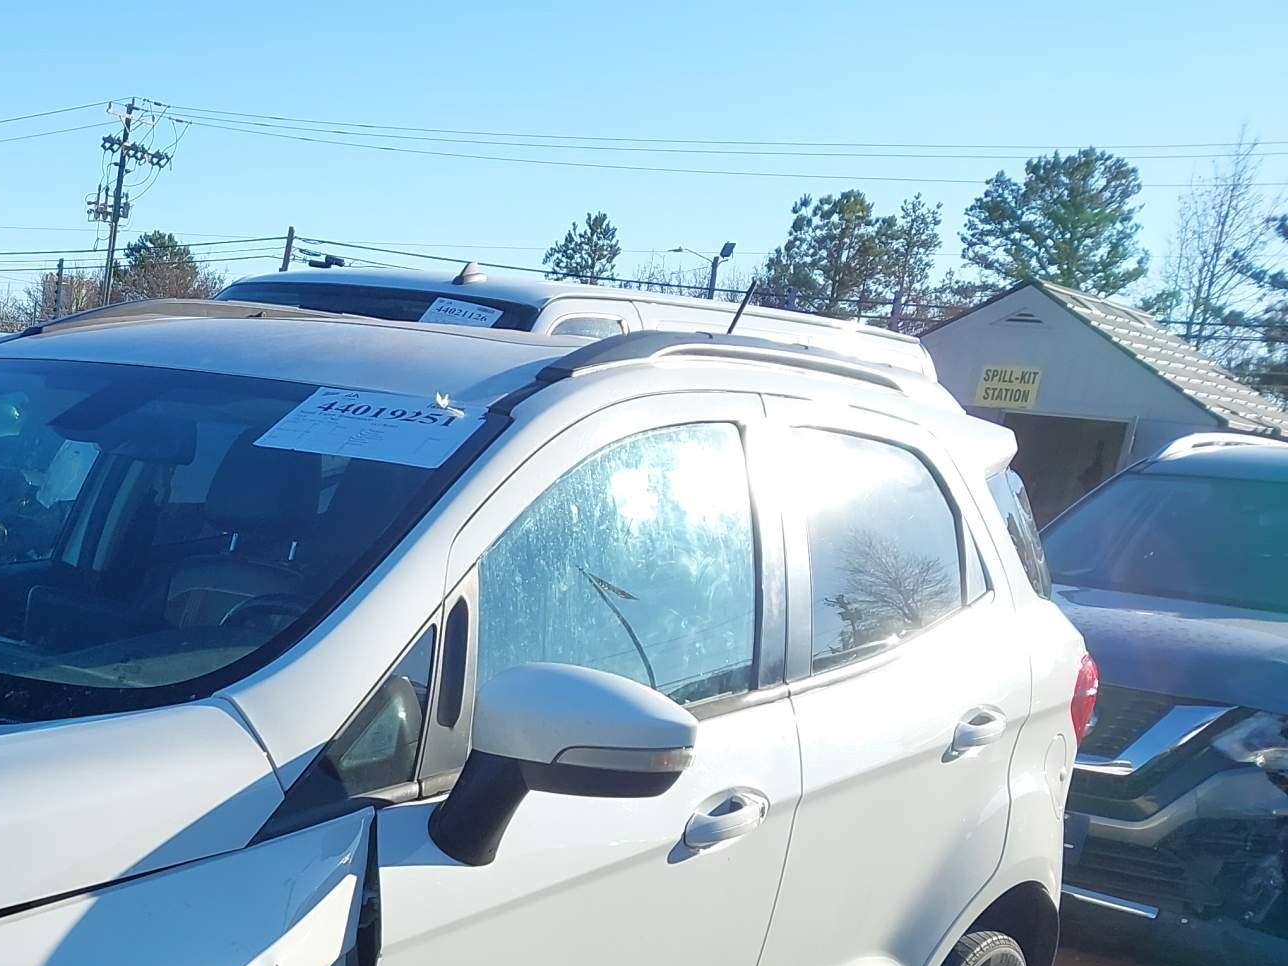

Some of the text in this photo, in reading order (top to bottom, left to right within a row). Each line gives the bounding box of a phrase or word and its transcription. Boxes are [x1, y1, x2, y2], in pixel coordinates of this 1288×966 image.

[435, 305, 488, 322] 44021126
[983, 368, 1040, 385] SPILL-KIT
[982, 386, 1031, 403] STATION
[316, 399, 458, 427] 44019251
